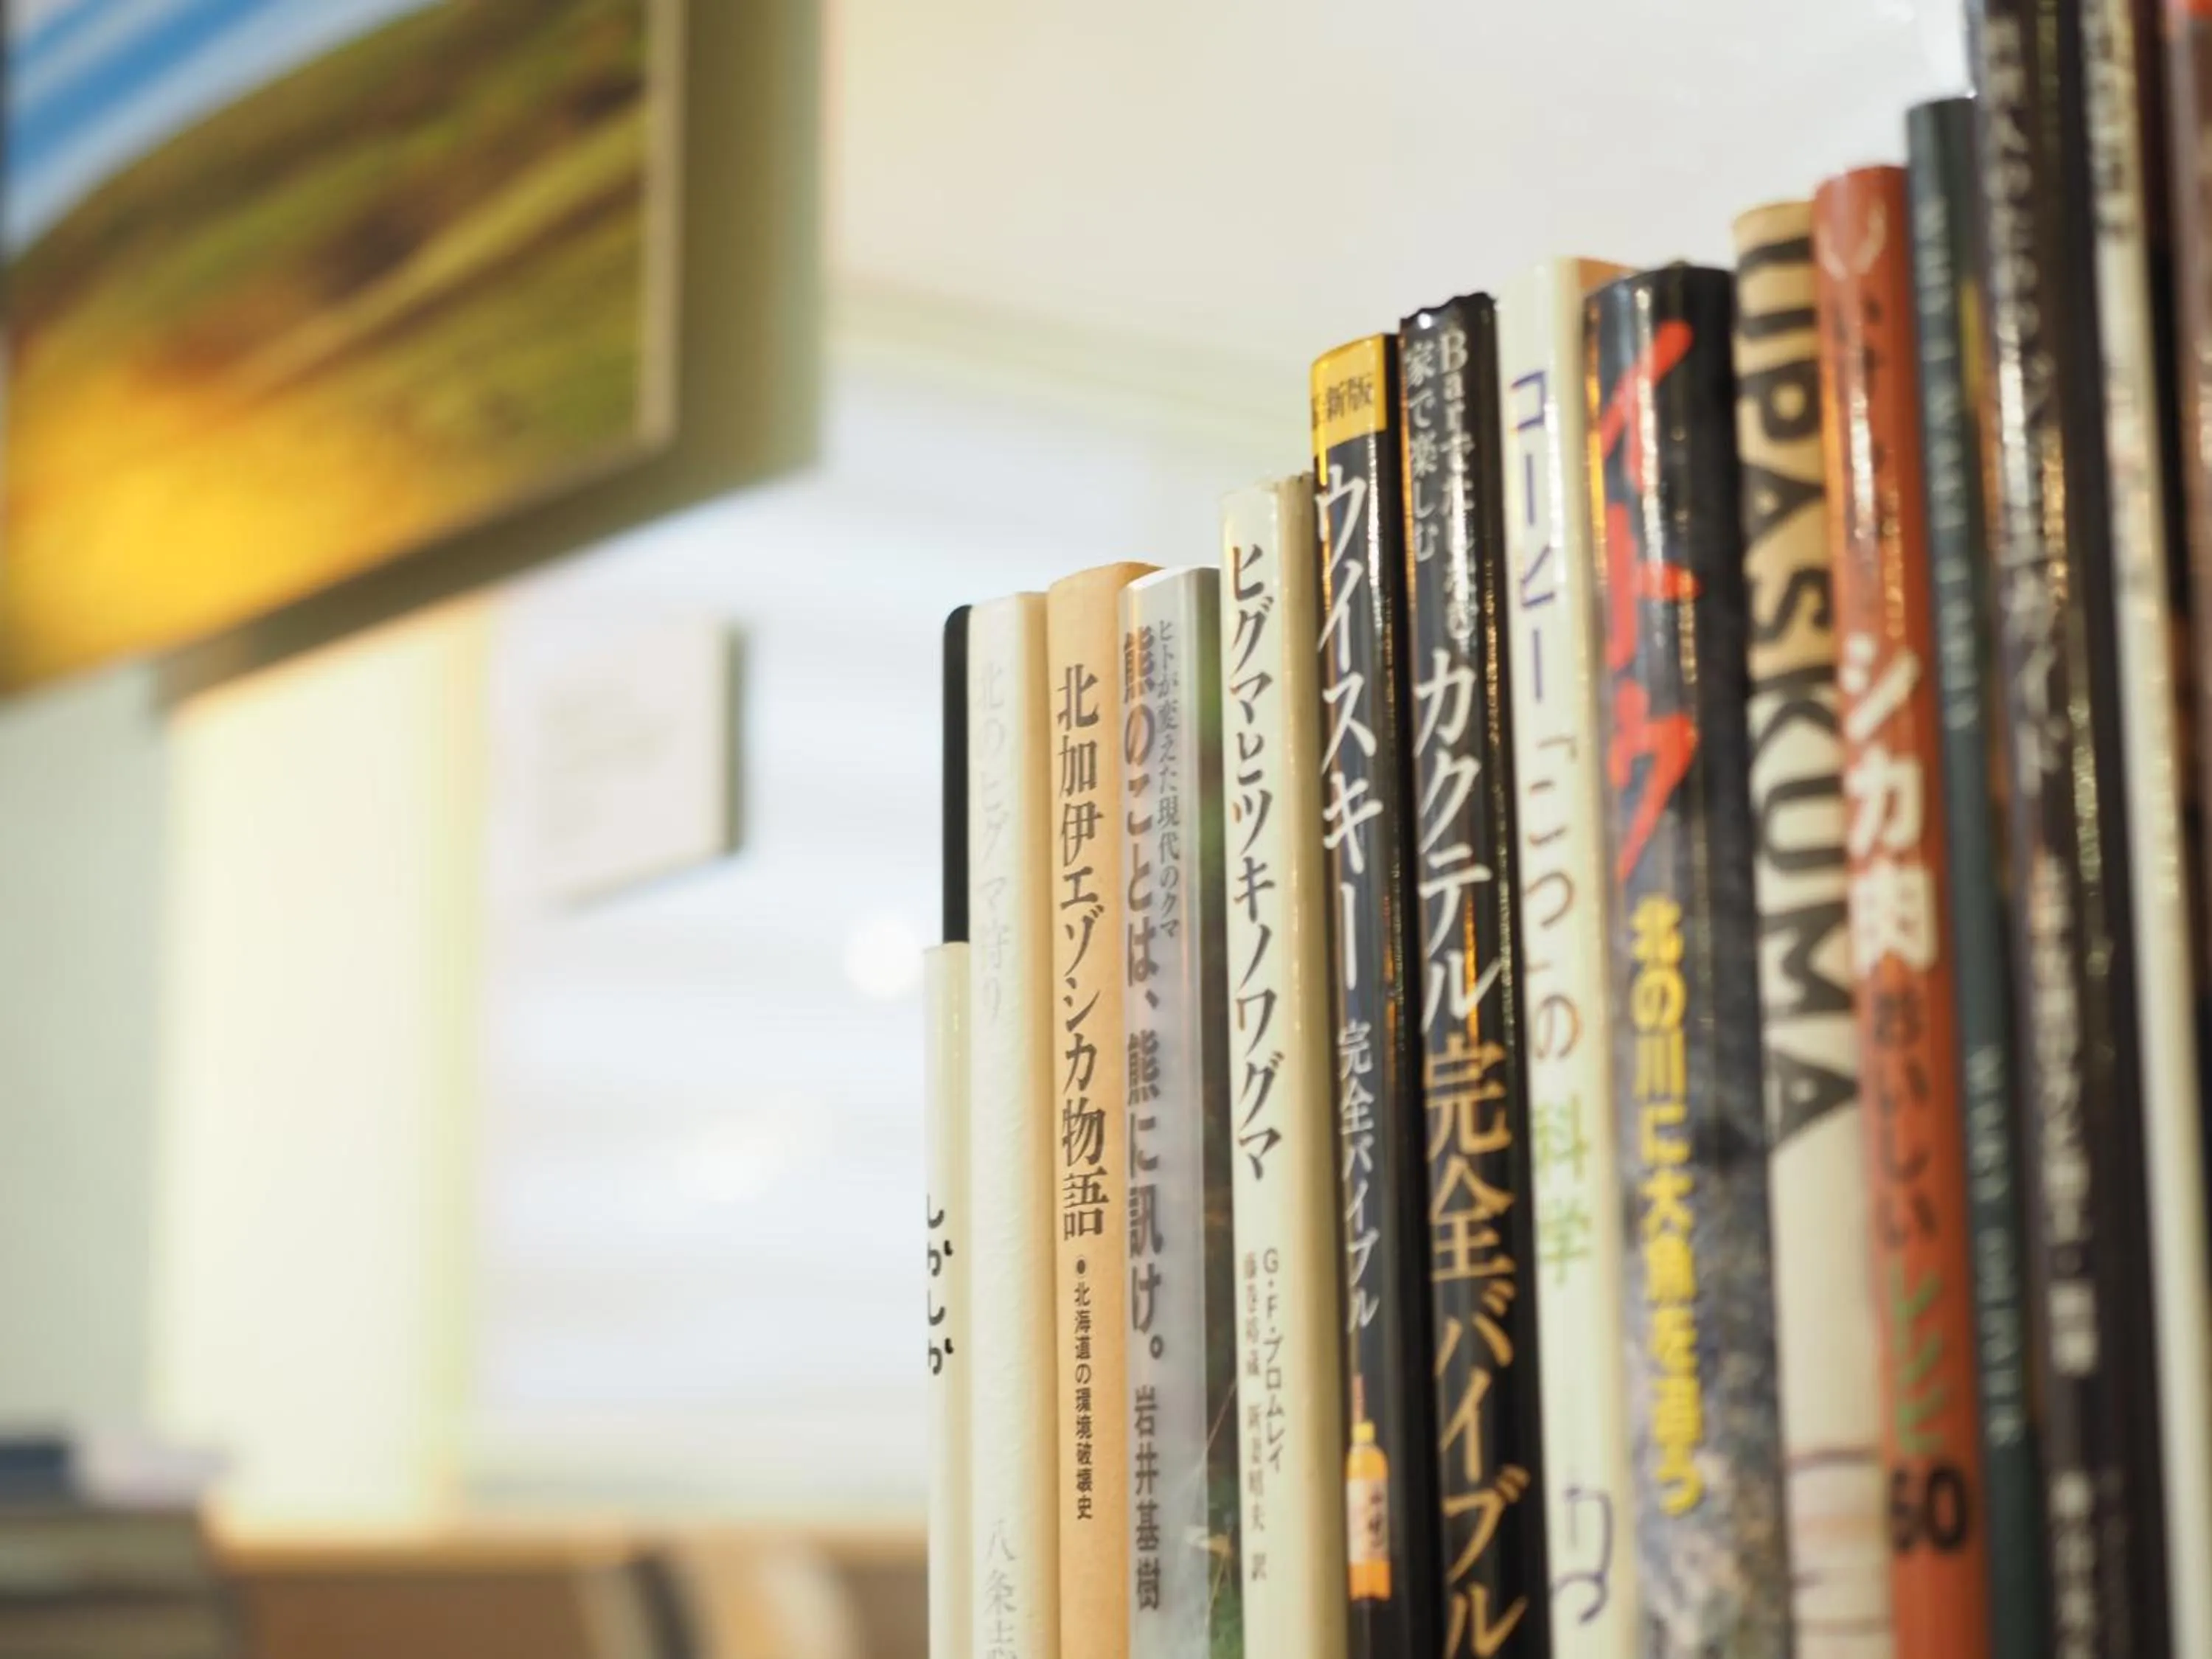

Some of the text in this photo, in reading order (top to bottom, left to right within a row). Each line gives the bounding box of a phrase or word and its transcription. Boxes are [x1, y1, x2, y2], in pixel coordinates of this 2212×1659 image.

[1158, 619, 1180, 939] ヒトが変えた現代のクマ
[1229, 543, 1284, 1181] ヒグマとツキノワグマ
[1316, 465, 1383, 1334] ウイスキー 完全バイブル
[1600, 319, 1705, 885] イトウ
[1057, 664, 1110, 1242] 北加伊エゾシカ物語
[1124, 625, 1165, 1360] 熊のことは、熊に訊け。
[1413, 646, 1530, 1659] カクテル完全バイブル
